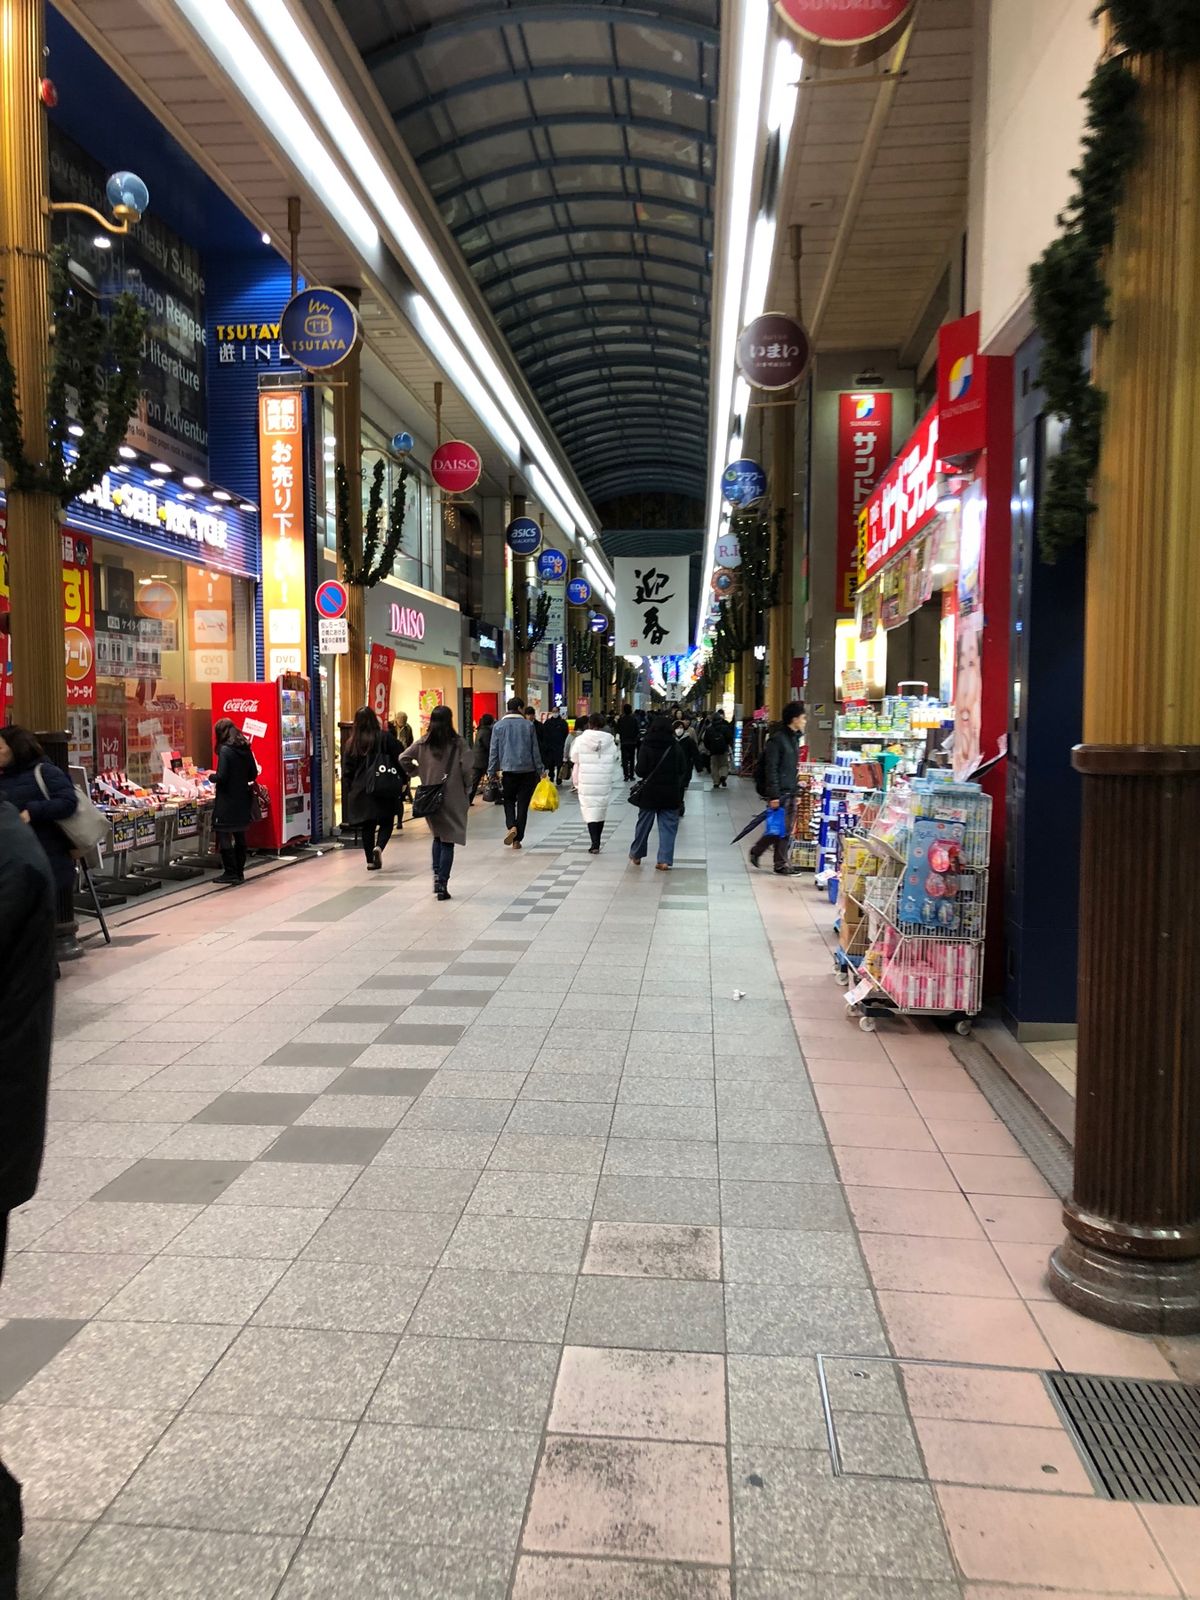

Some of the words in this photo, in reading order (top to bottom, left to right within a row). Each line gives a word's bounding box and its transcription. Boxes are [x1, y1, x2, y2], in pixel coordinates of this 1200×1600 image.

[165, 294, 207, 347] Reggae
[216, 323, 280, 341] TSUTAY
[292, 338, 346, 351] TSUTAYA
[749, 343, 800, 358] いまい
[150, 338, 200, 392] literature
[432, 458, 478, 470] DAISO
[511, 527, 536, 538] asics
[632, 567, 676, 645] 迎春
[391, 603, 425, 640] DAISO
[275, 655, 296, 663] DVD
[223, 699, 259, 713] Coca-Cola
[101, 737, 119, 752] トレカ
